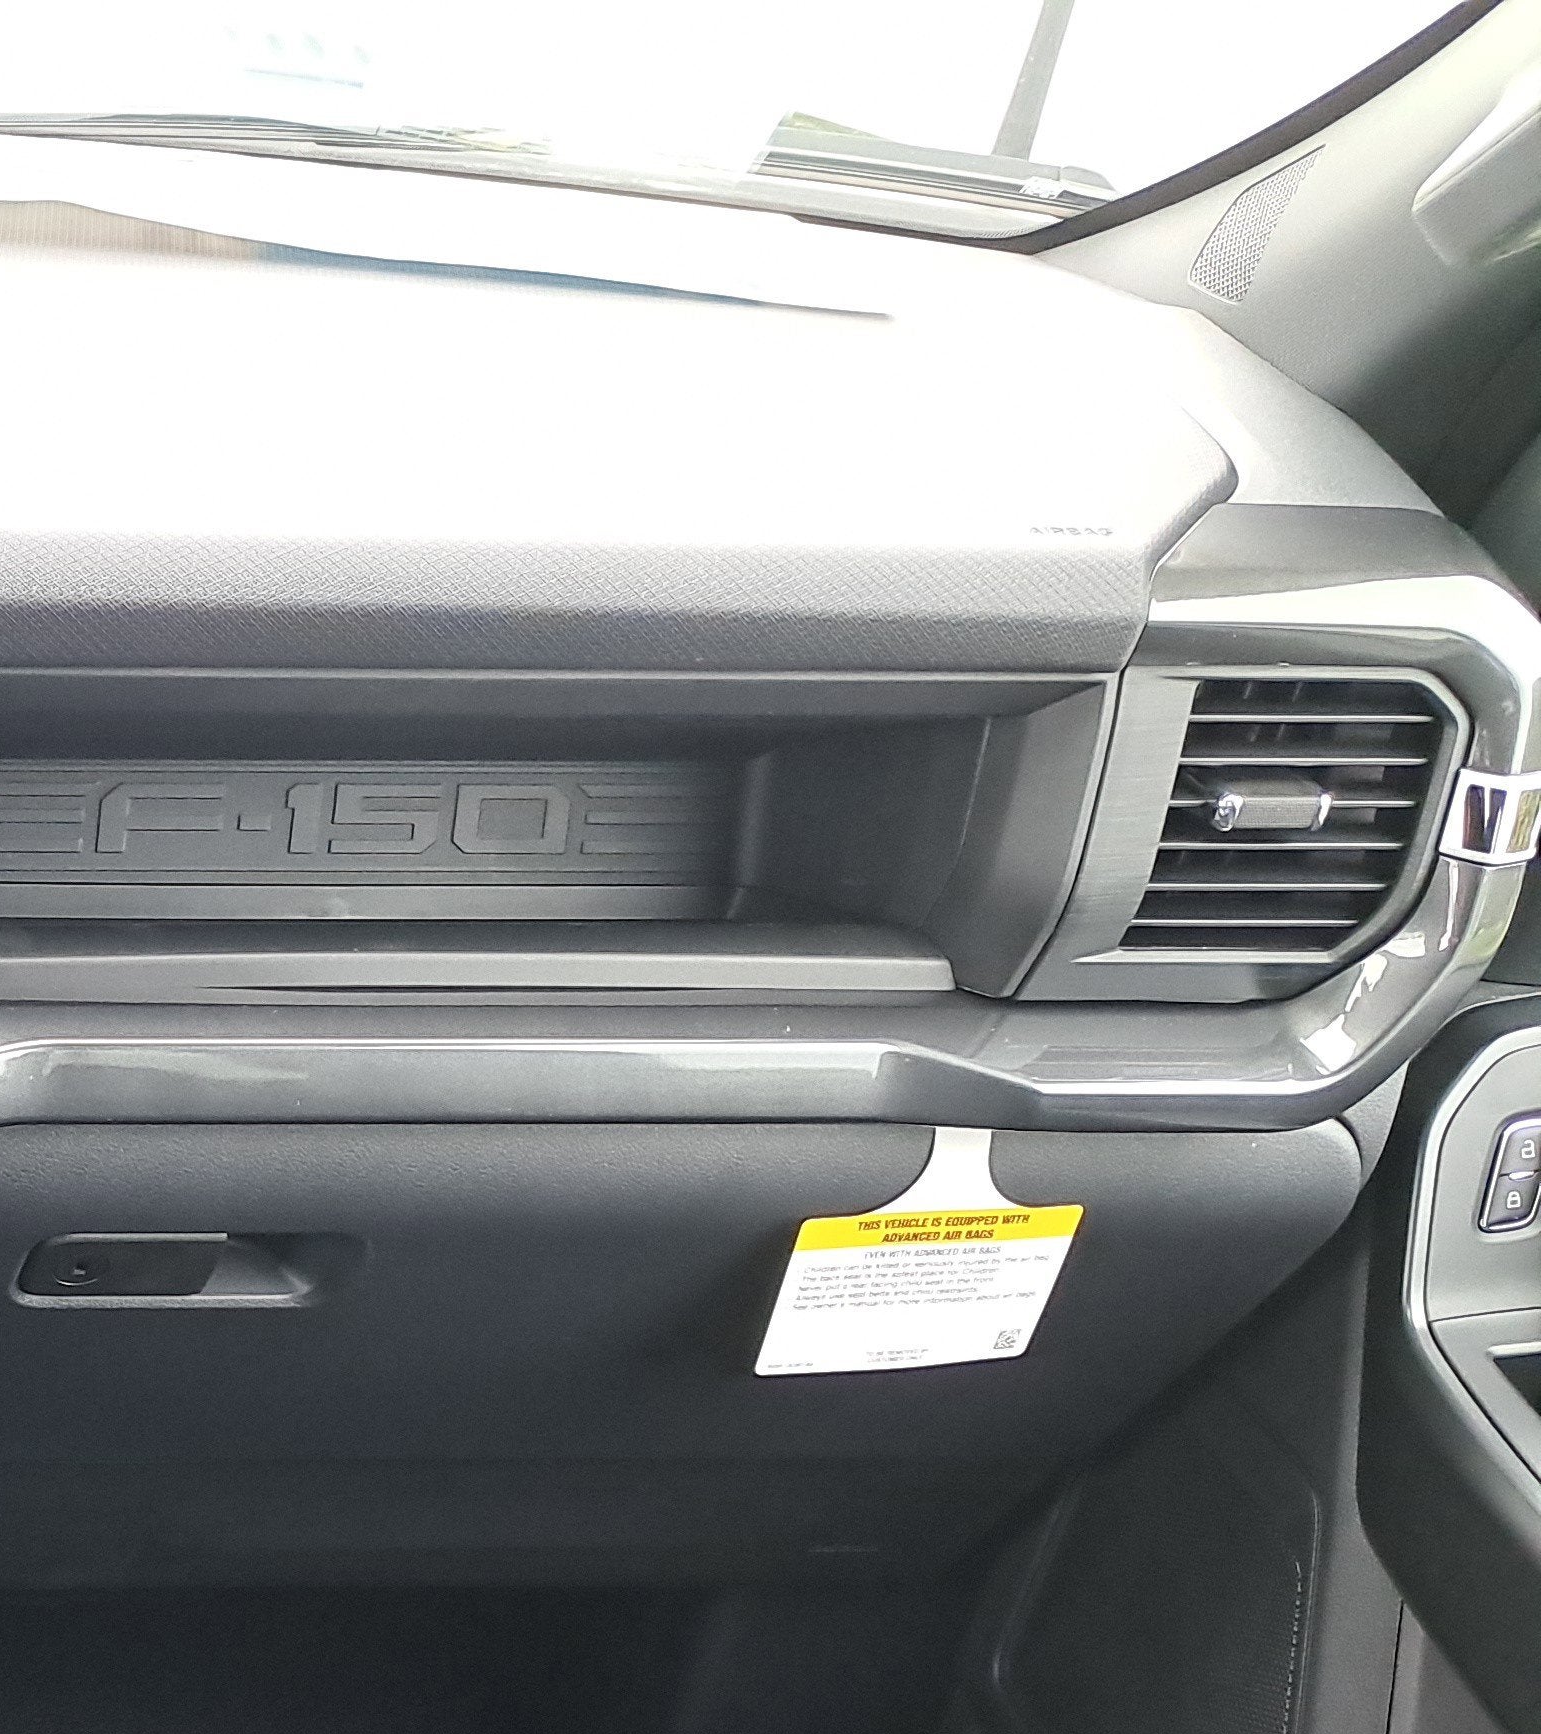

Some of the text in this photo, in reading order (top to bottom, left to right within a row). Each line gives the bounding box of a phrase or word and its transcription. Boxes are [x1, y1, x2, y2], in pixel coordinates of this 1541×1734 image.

[96, 782, 571, 855] F-150
[858, 1214, 1030, 1231] THIS VEHICLE IS EQUIPPED WITH
[882, 1229, 994, 1243] ADVANCED AIR BAGS
